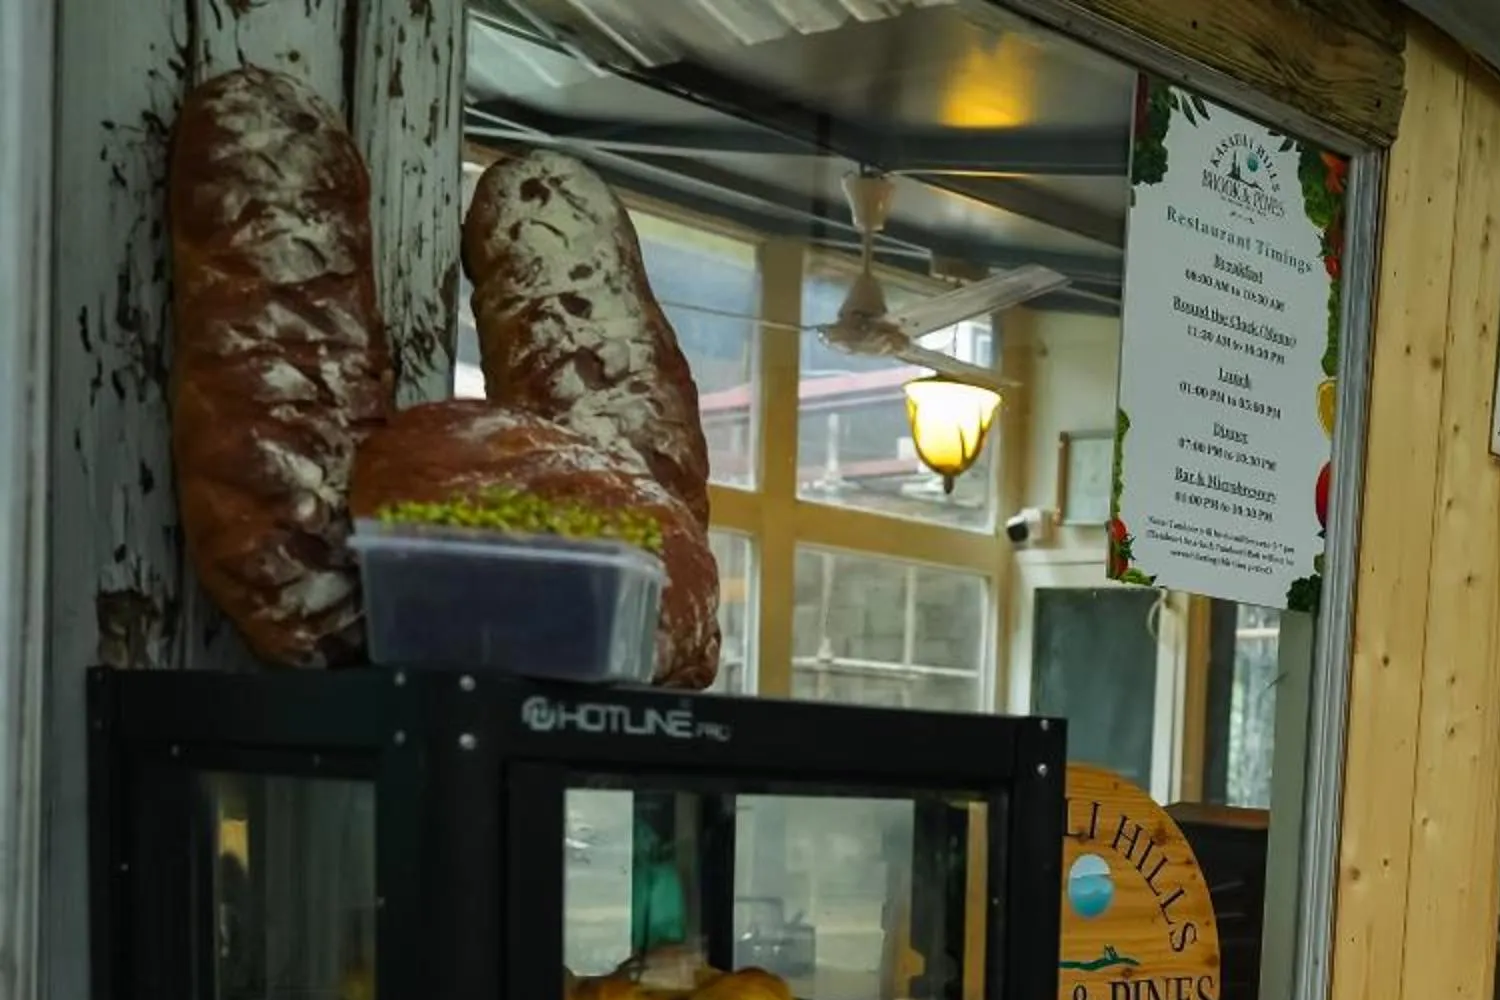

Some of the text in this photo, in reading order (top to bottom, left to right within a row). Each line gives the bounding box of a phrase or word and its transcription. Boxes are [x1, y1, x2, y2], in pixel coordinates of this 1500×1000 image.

[1167, 205, 1251, 250] Restaurant
[1255, 239, 1313, 274] Timings
[1218, 368, 1250, 389] Lunch
[1210, 390, 1225, 403] PM
[1266, 406, 1281, 420] PM
[1174, 466, 1195, 485] Bar
[1258, 510, 1273, 523] PM
[557, 703, 693, 738] HOTLINE
[1112, 814, 1198, 953] HILLS
